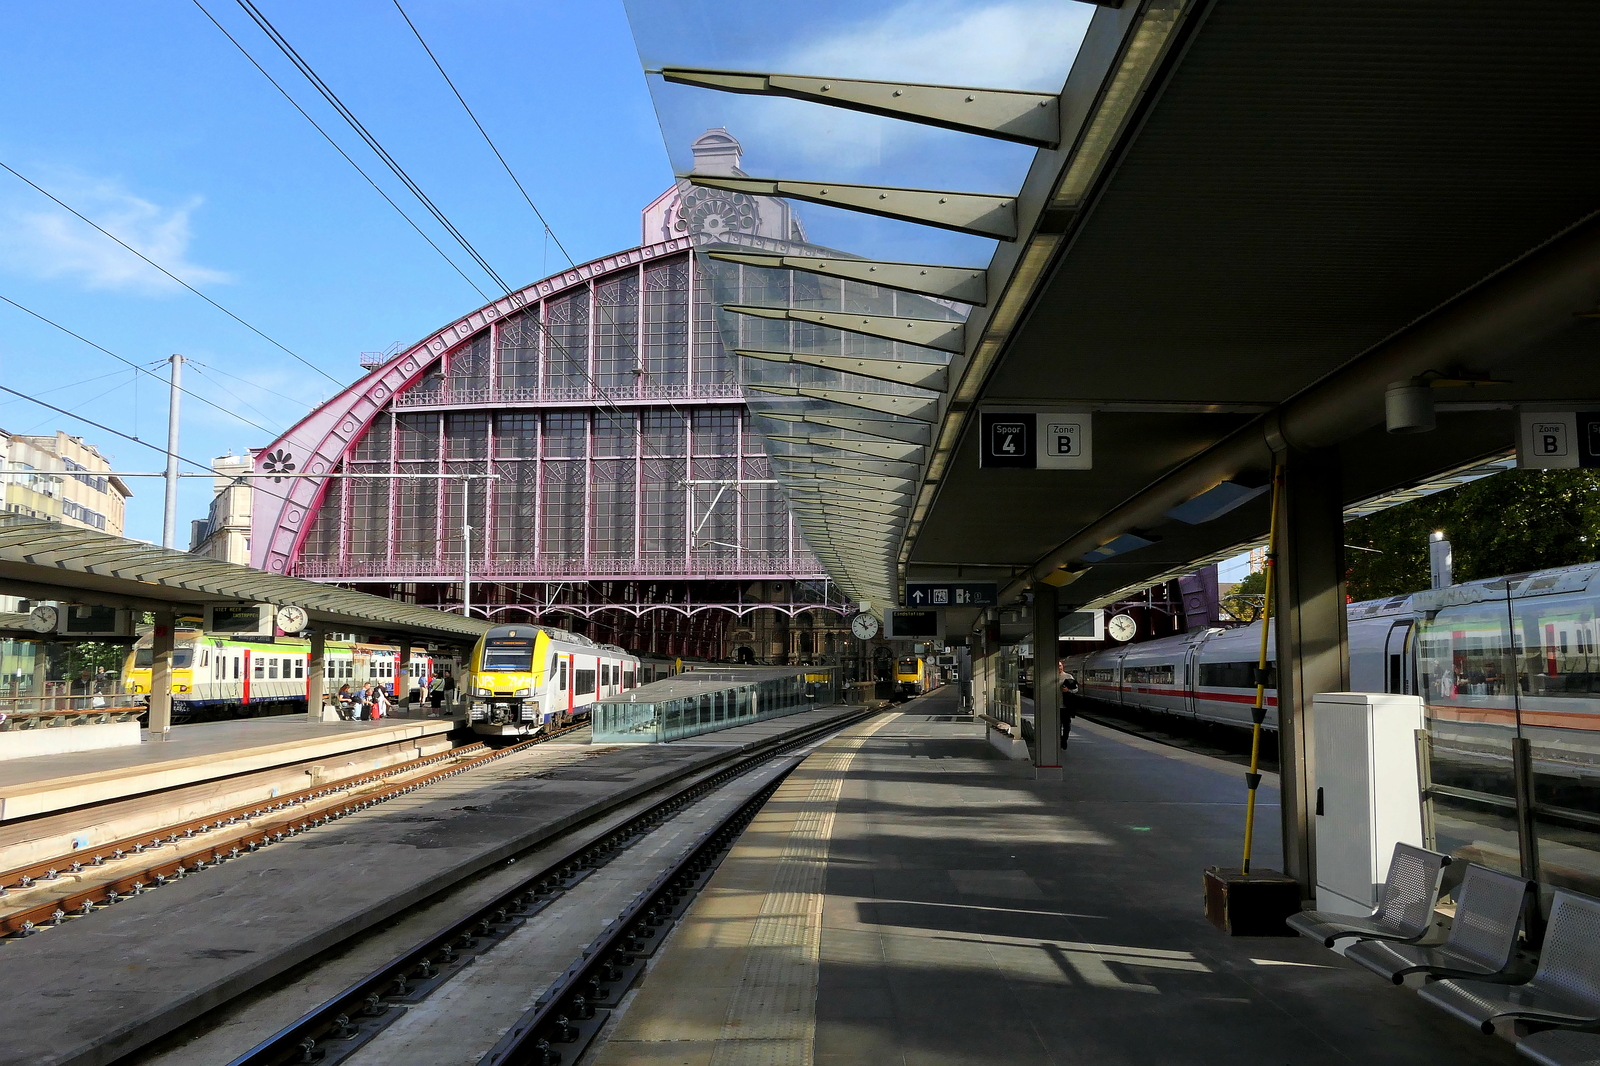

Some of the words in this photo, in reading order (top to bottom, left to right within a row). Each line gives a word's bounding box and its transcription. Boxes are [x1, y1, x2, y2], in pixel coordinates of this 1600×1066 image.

[996, 425, 1021, 435] Spoor
[1002, 434, 1016, 453] 4
[1057, 435, 1071, 454] B
[1543, 435, 1558, 453] B
